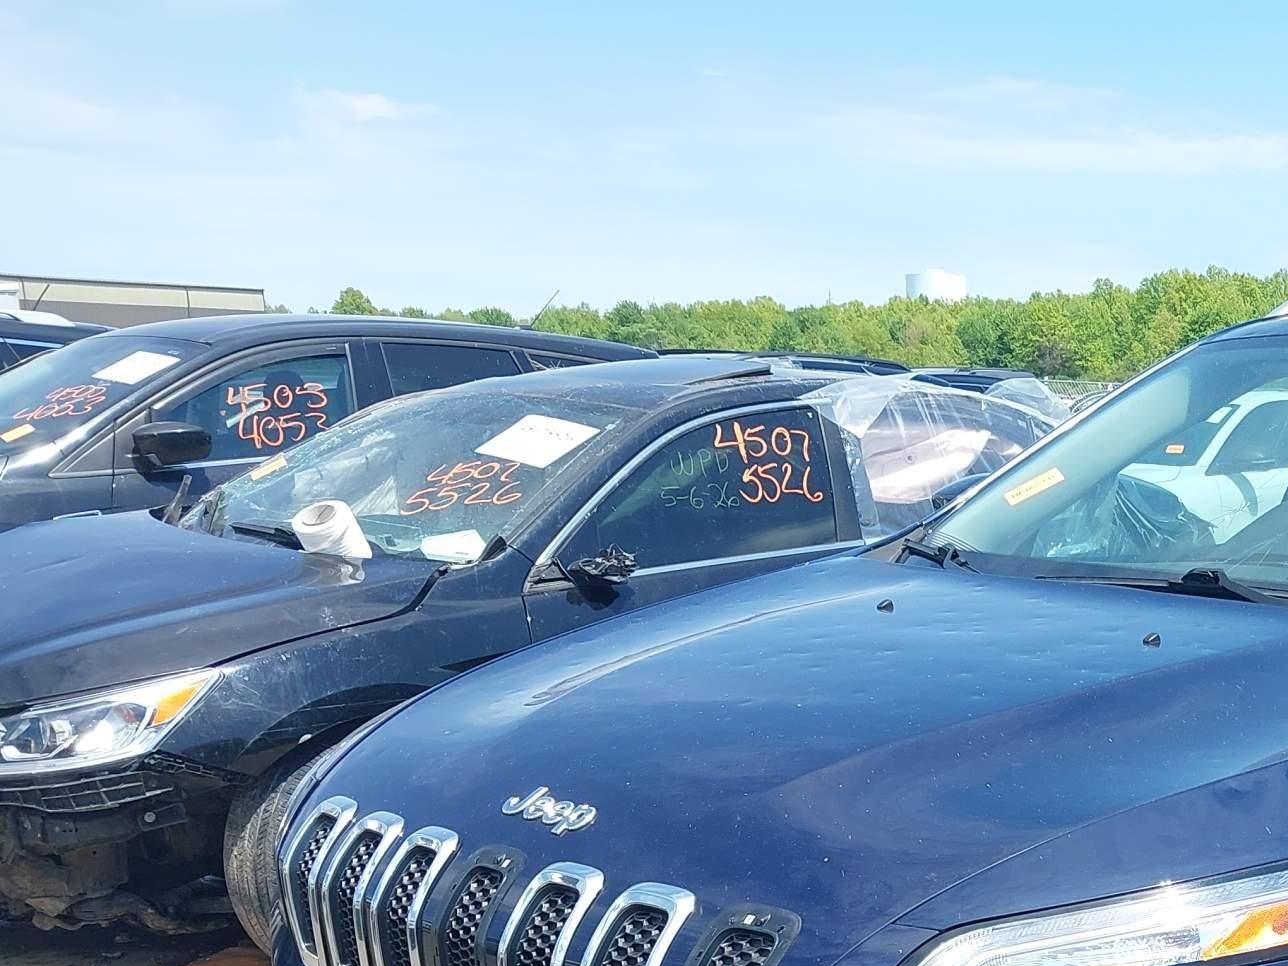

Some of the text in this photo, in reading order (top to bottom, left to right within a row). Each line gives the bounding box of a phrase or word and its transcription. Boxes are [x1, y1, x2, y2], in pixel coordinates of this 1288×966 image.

[714, 421, 811, 464] 4507
[400, 480, 522, 515] 5526
[738, 462, 824, 503] 5526
[501, 785, 598, 838] Jeep
